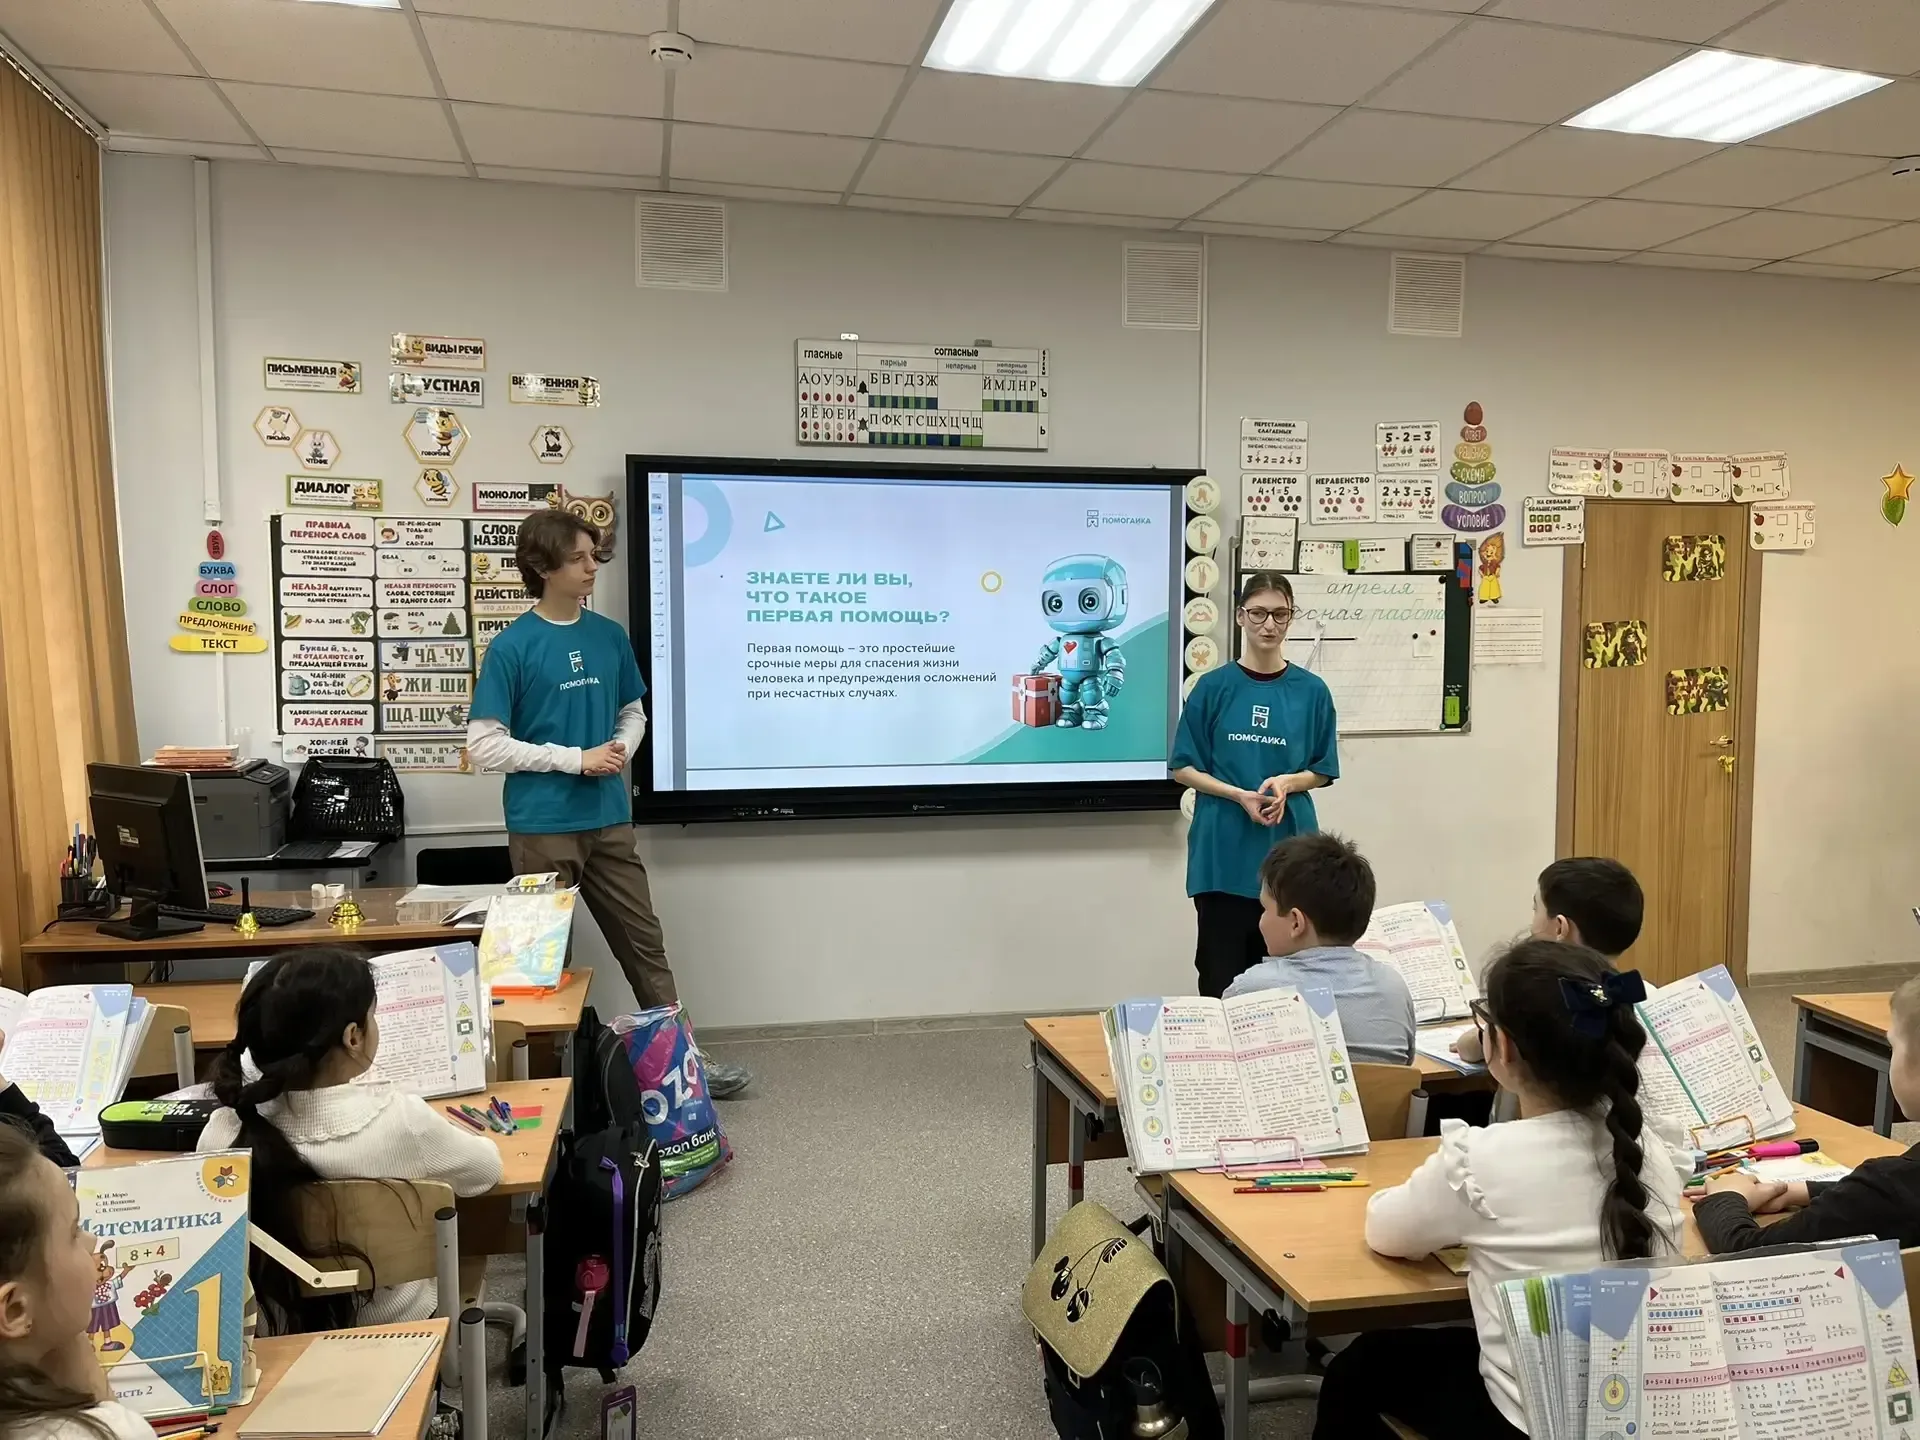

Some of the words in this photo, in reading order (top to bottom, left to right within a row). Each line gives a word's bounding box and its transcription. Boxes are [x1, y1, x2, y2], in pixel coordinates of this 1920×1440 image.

[425, 344, 456, 354] ВИДЫ
[459, 346, 482, 354] РЕЧИ
[804, 349, 843, 360] гласные
[934, 348, 979, 357] согласные
[881, 359, 907, 367] парные
[267, 364, 336, 375] ПИСЬМЕННАЯ
[422, 378, 480, 392] УСТНАЯ
[800, 373, 810, 384] А
[811, 374, 821, 385] О
[822, 374, 832, 386] У
[835, 375, 844, 386] Э
[846, 376, 856, 387] Ы
[870, 373, 878, 384] Б
[882, 373, 890, 384] В
[895, 374, 902, 384] Г
[904, 374, 914, 387] Д
[917, 375, 924, 386] З
[926, 375, 938, 386] Ж
[983, 378, 992, 390] Й
[994, 381, 1005, 390] М
[1007, 381, 1016, 391] Л
[1018, 381, 1027, 391] Н
[1030, 381, 1036, 392] Р
[1041, 388, 1047, 397] Ъ
[800, 408, 808, 418] Я
[812, 405, 819, 418] Ё
[822, 408, 833, 419] Ю
[837, 409, 844, 419] Е
[847, 409, 855, 420] И
[870, 414, 878, 425] П
[882, 414, 892, 425] Ф
[893, 415, 902, 426] К
[905, 415, 914, 426] Т
[916, 416, 924, 426] С
[926, 416, 938, 426] Ш
[938, 416, 947, 427] Х
[950, 416, 959, 429] Ц
[962, 417, 970, 427] Ч
[972, 417, 982, 429] Щ
[1040, 426, 1046, 435] Ь
[1386, 433, 1392, 442] 5
[1403, 432, 1410, 442] 2
[1424, 431, 1431, 441] 3
[1461, 468, 1485, 481] СХЕМА
[295, 482, 350, 494] ДИАЛОГ
[1383, 487, 1389, 496] 2
[1404, 487, 1410, 496] 3
[1424, 487, 1431, 496] 5
[479, 490, 528, 499] МОНОЛОГ
[1459, 491, 1486, 504] ВОПРОС
[306, 521, 350, 529] ПРАВИЛА
[1456, 514, 1490, 528] УСЛОВИЕ
[290, 531, 339, 539] ПЕРЕНОСА
[342, 532, 367, 540] СЛОВ
[474, 535, 519, 545] НАЗВА
[200, 566, 234, 574] БУКВА
[747, 572, 830, 585] ЗНАЕТЕ
[836, 572, 867, 586] ЛИ
[874, 573, 913, 588] ВЫ,
[201, 584, 234, 594] СЛОГ
[474, 587, 540, 600] ДЕЙСТВИ
[1327, 582, 1415, 601] апреля
[747, 591, 789, 604] ЧТО
[796, 591, 867, 604] ТАКОЕ
[196, 601, 241, 612] СЛОВО
[1292, 605, 1363, 620] ссная
[747, 610, 834, 623] ПЕРВАЯ
[840, 611, 950, 625] ПОМОЩЬ?
[180, 616, 254, 632] ПРЕДЛОЖЕНИЕ
[478, 621, 514, 631] ПРИЗ
[201, 639, 238, 648] ТЕКСТ
[747, 642, 791, 654] Первая
[795, 644, 844, 655] помощь
[859, 644, 879, 653] это
[882, 644, 955, 656] простейшие
[747, 660, 800, 670] срочные
[804, 660, 836, 670] меры
[840, 660, 862, 670] для
[865, 659, 919, 669] спасения
[923, 659, 959, 668] жизни
[747, 674, 803, 684] человека
[808, 675, 814, 683] и
[818, 673, 920, 685] предупреждения
[924, 672, 996, 683] осложнений
[747, 689, 770, 700] при
[774, 688, 844, 698] несчастных
[849, 688, 897, 698] случаях.
[294, 718, 363, 727] РАЗДЕЛЯЕМ
[659, 1141, 690, 1158] ozon
[690, 1128, 717, 1147] банк
[130, 1250, 138, 1261] 8
[157, 1244, 164, 1257] 4
[184, 1273, 231, 1370] 1
[112, 1388, 143, 1399] асть
[146, 1386, 152, 1396] 2
